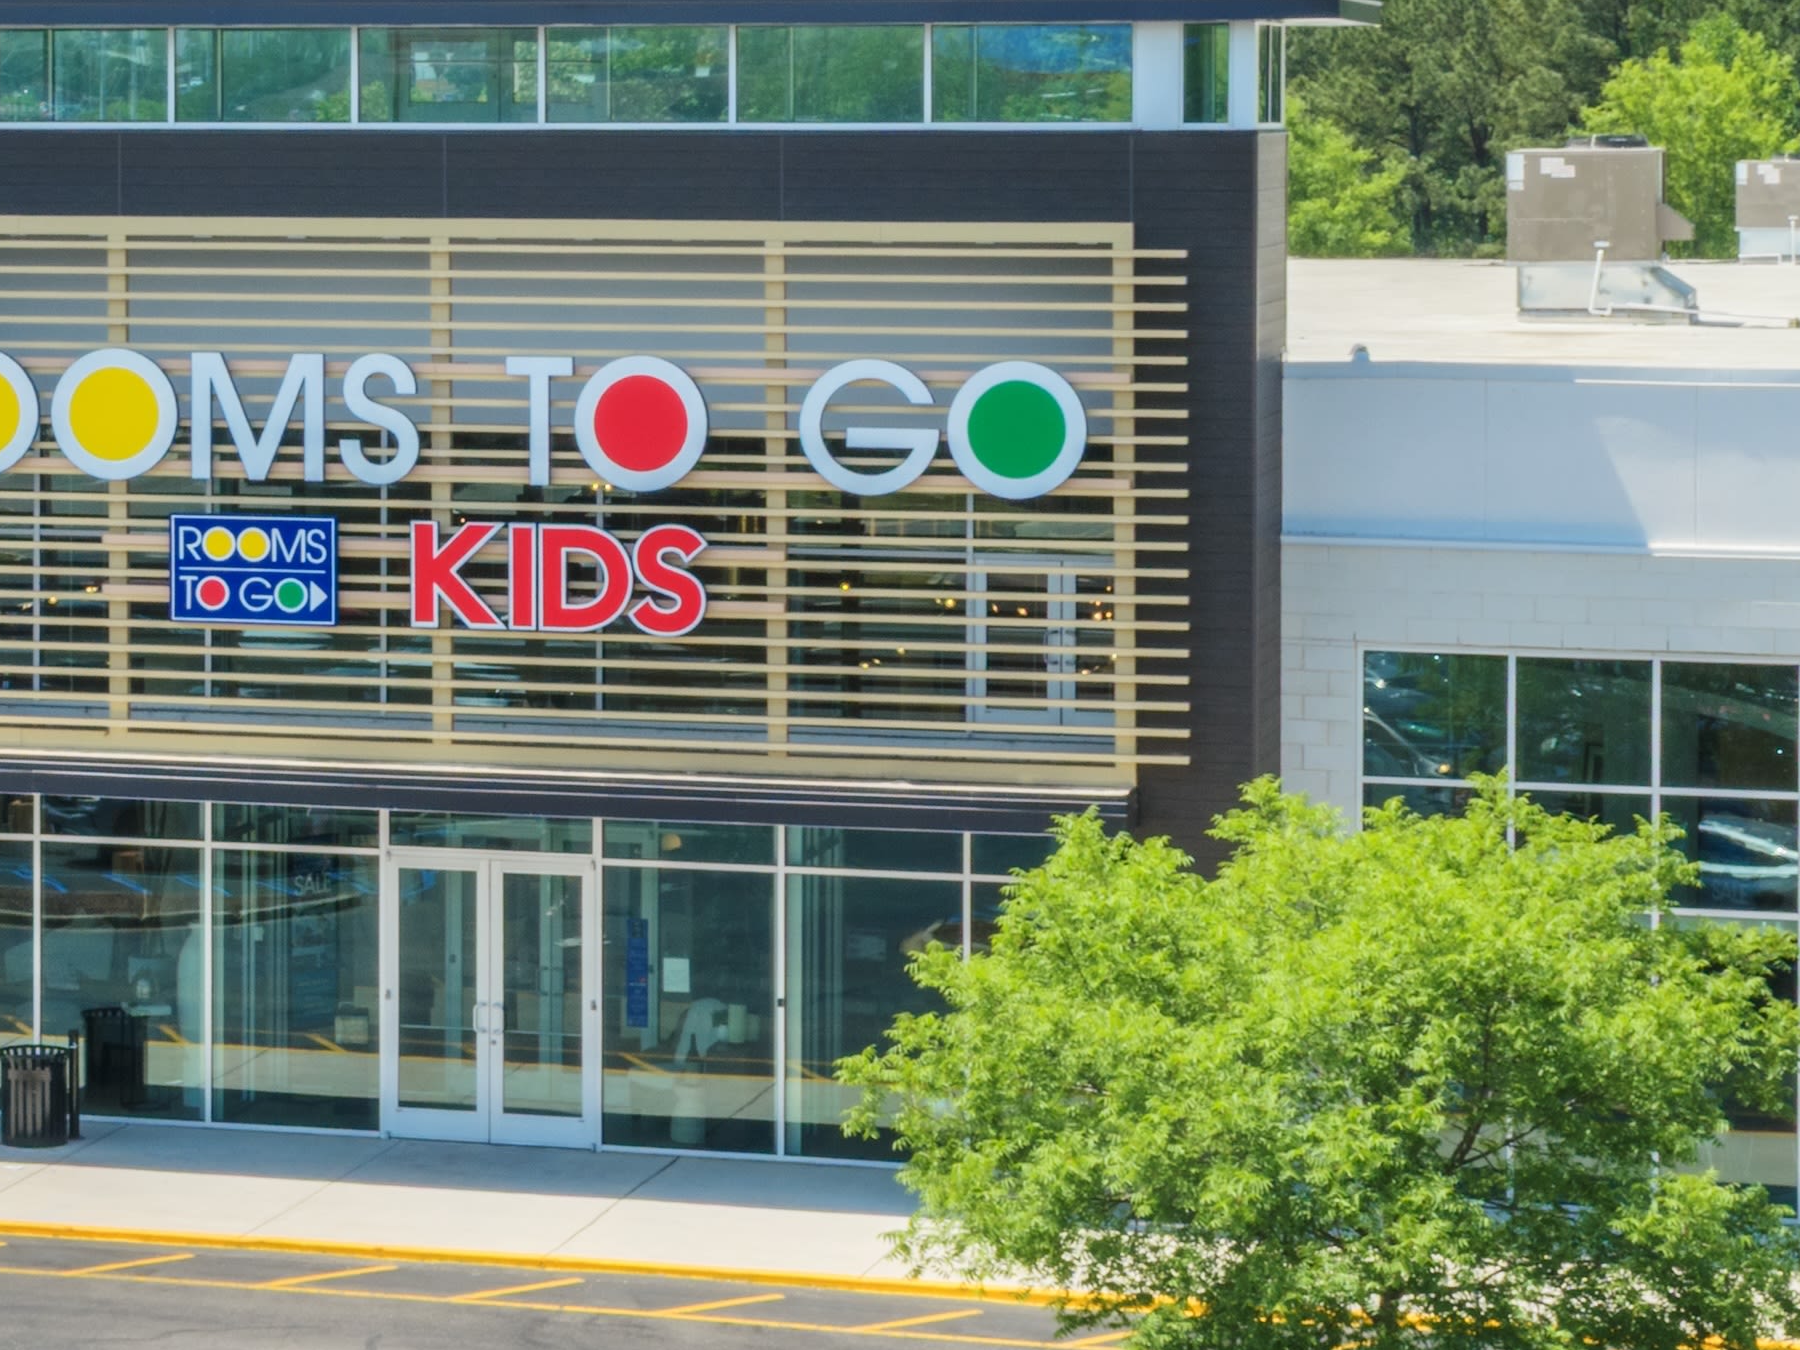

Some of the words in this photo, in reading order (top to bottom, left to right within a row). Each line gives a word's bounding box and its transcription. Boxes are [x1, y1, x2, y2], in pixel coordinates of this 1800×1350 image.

[505, 354, 708, 492] TO
[800, 358, 1088, 500] GO
[177, 525, 327, 565] ROOMS
[410, 519, 707, 637] KIDS
[178, 575, 230, 611] TO
[238, 576, 309, 614] GO
